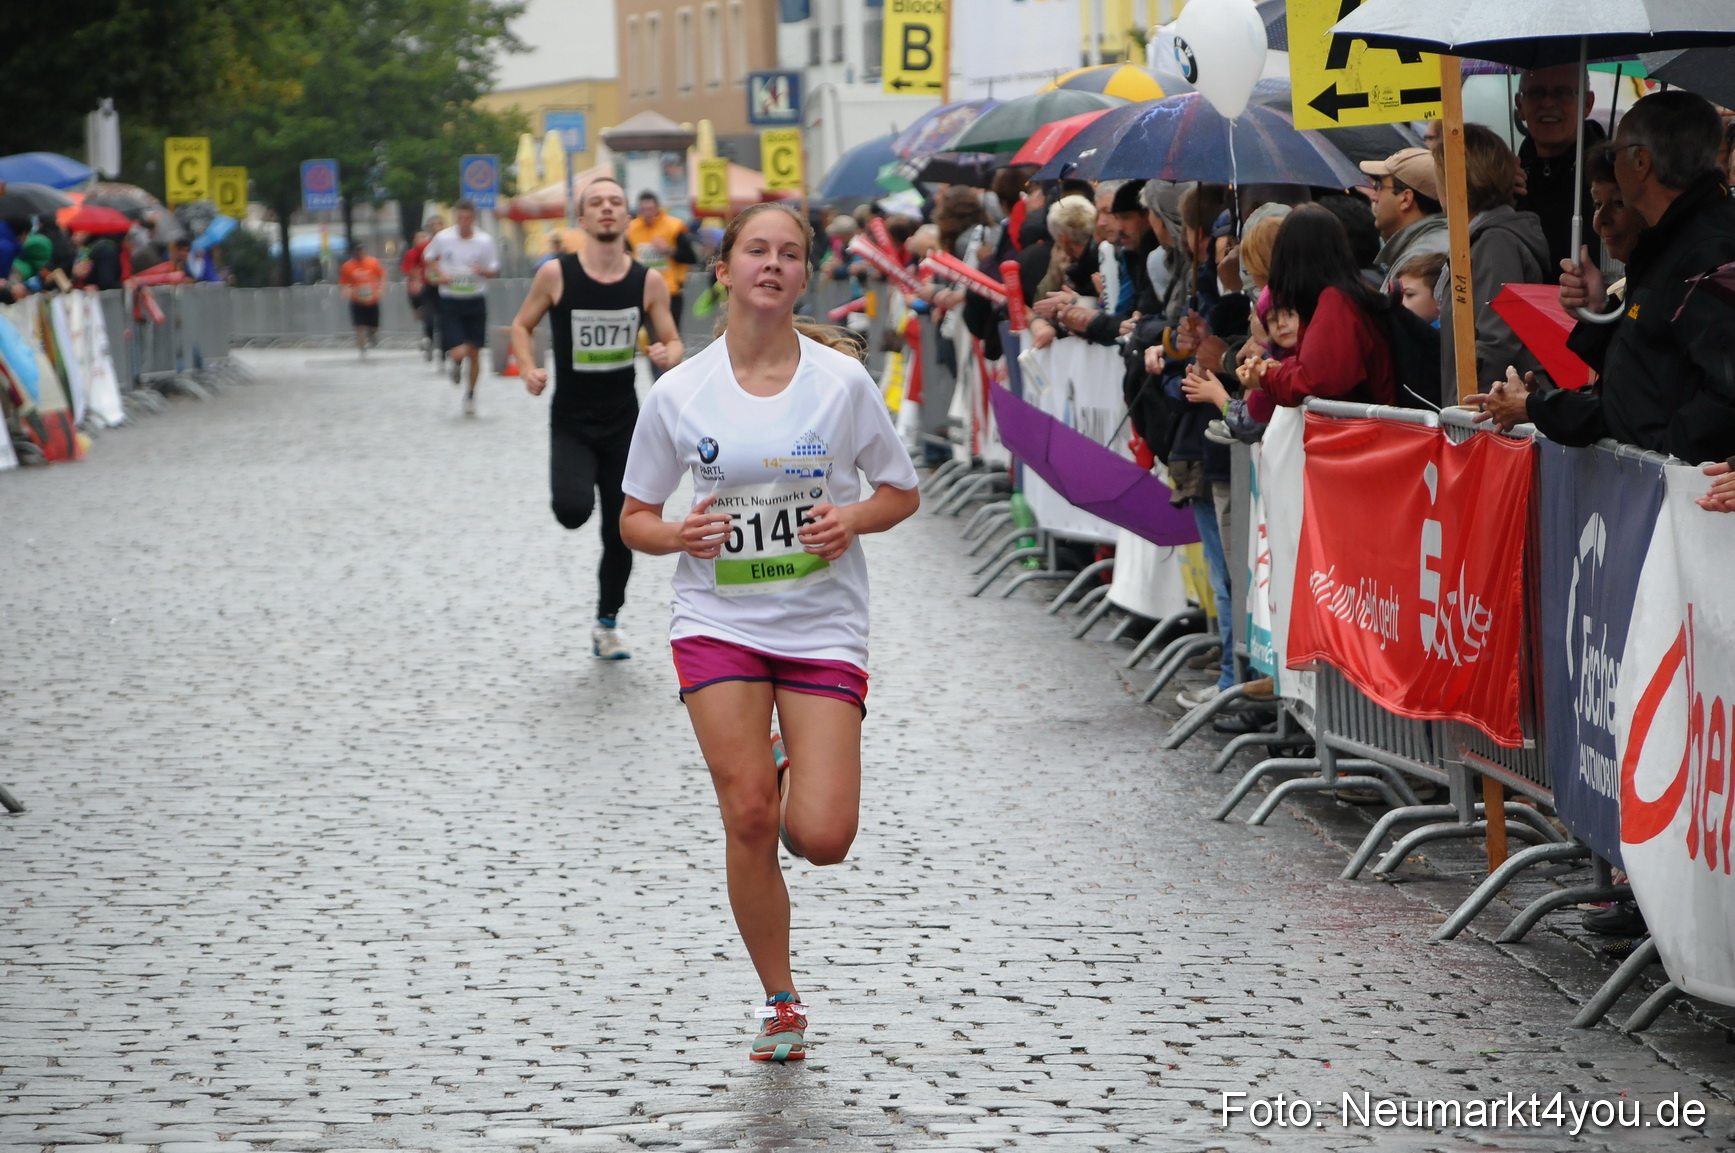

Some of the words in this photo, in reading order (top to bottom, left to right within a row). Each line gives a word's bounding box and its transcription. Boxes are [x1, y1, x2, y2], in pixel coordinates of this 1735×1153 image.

[903, 23, 932, 70] B
[176, 156, 199, 187] C
[773, 147, 791, 176] C
[220, 182, 237, 205] D
[704, 173, 721, 196] D
[580, 324, 631, 347] 5071
[700, 466, 724, 475] PARTL
[751, 491, 804, 506] Neumarkt
[751, 563, 795, 579] Elena
[1379, 585, 1400, 650] geht
